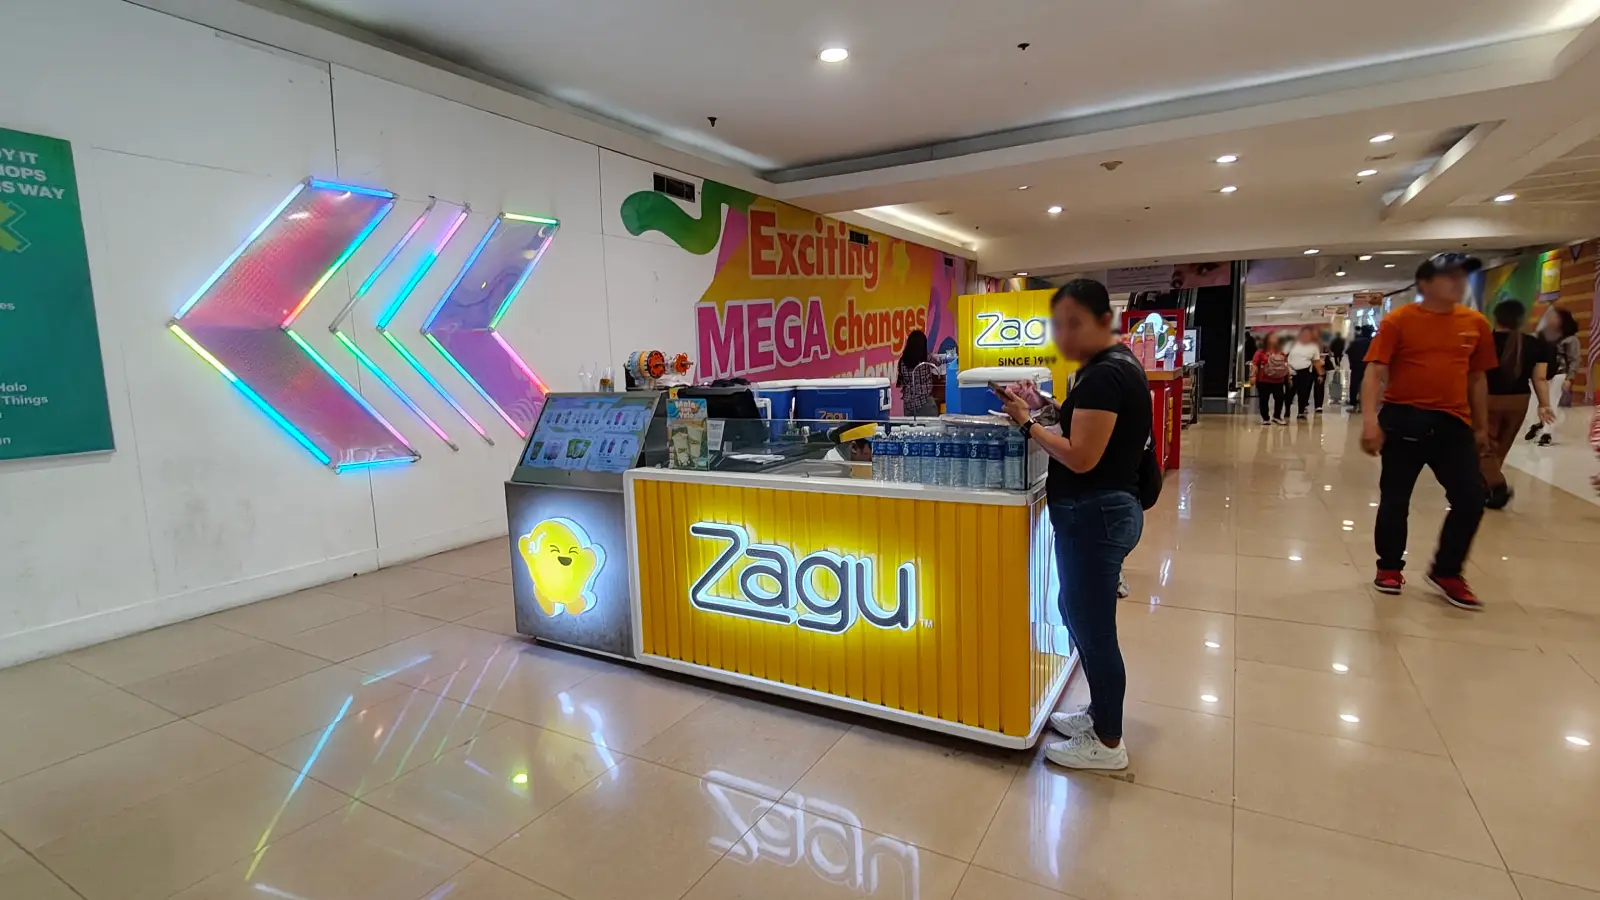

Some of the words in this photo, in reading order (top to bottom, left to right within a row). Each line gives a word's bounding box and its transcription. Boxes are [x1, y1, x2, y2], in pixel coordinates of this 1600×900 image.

[0, 147, 15, 161] Y
[19, 151, 39, 164] IT
[0, 180, 15, 194] S
[17, 183, 65, 200] WAY
[750, 209, 879, 290] Exciting
[0, 302, 15, 311] es
[694, 298, 830, 380] MEGA
[832, 297, 927, 355] changes
[975, 312, 1050, 348] Zag
[998, 357, 1031, 367] SINCE
[3, 395, 48, 407] Things
[689, 521, 917, 635] Zagu
[919, 618, 934, 629] TM
